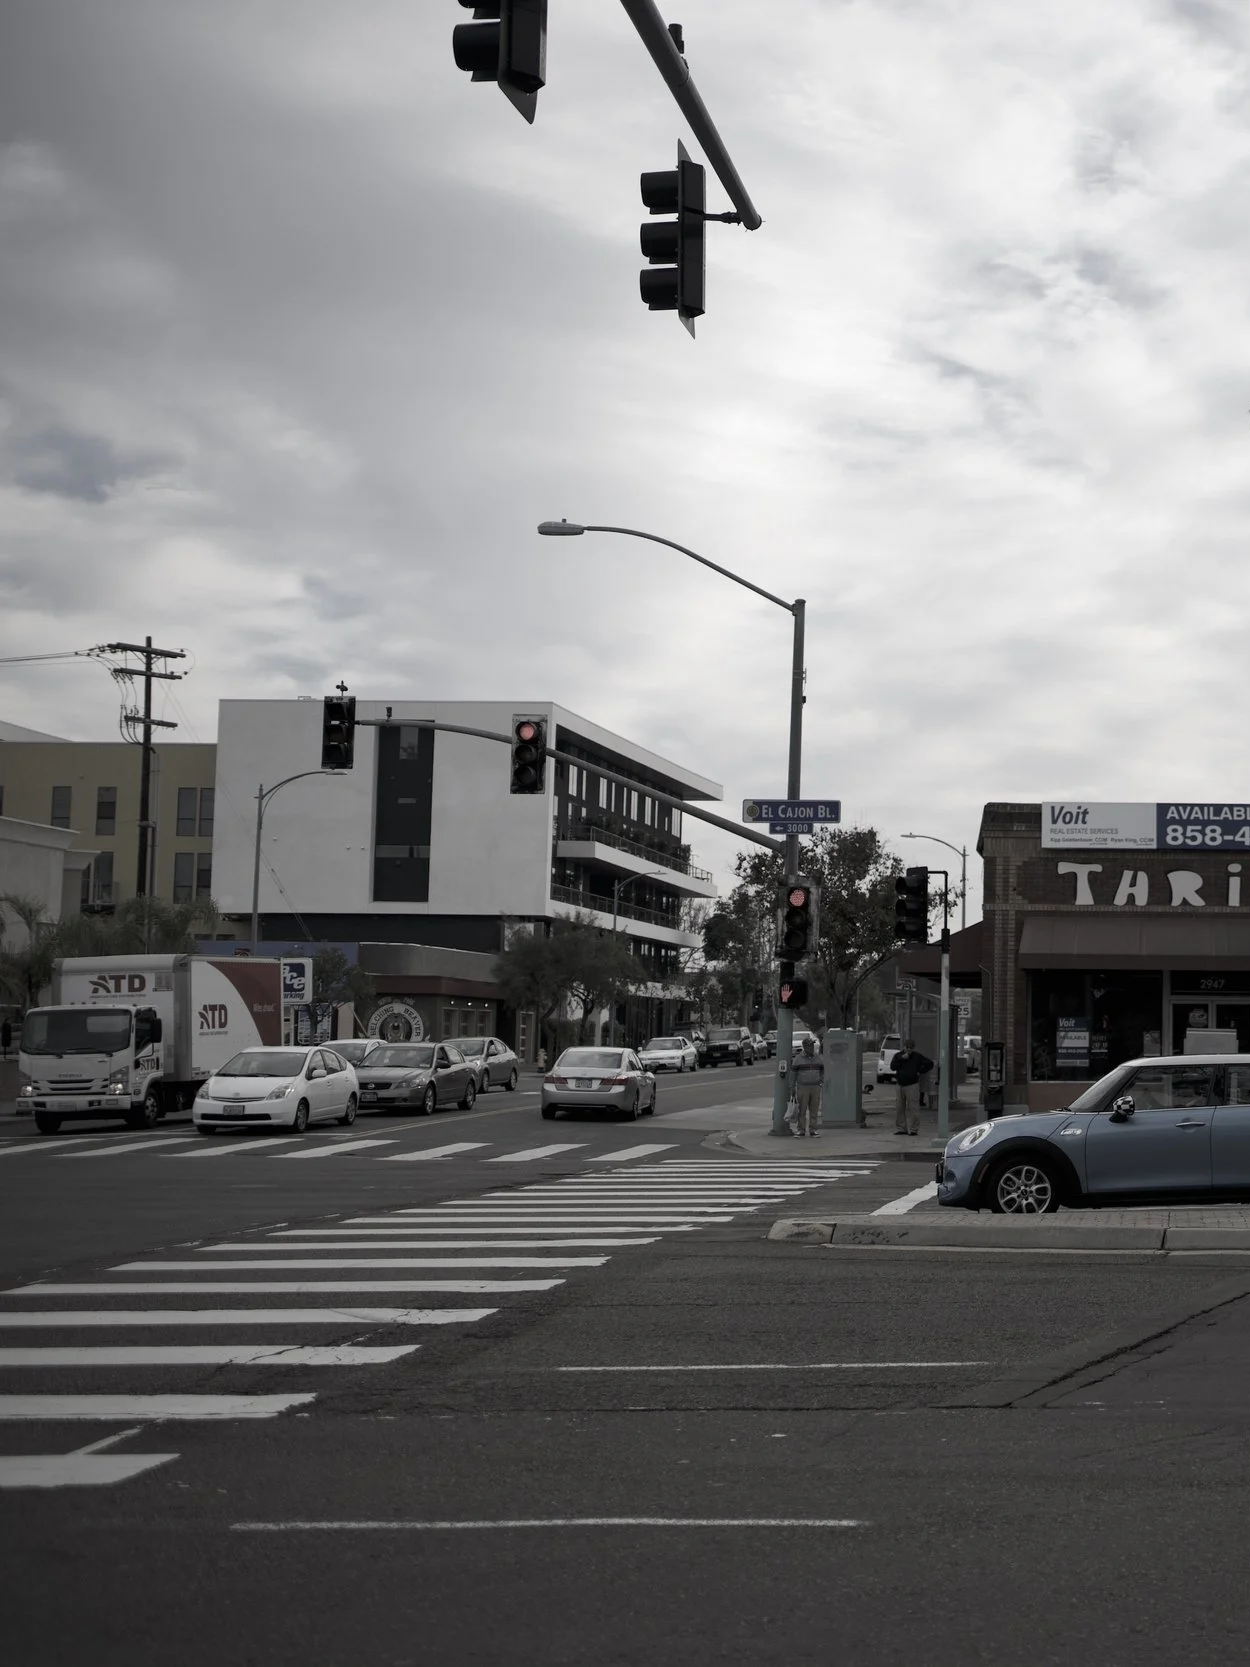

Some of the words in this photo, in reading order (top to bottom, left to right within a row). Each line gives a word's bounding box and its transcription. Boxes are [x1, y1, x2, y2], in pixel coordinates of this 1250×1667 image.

[1051, 806, 1089, 825] Voit
[787, 823, 808, 832] 3000
[89, 975, 146, 994] ATD
[198, 1004, 228, 1030] ATD
[370, 1006, 394, 1037] BELCHING
[403, 1007, 421, 1037] BEAVER
